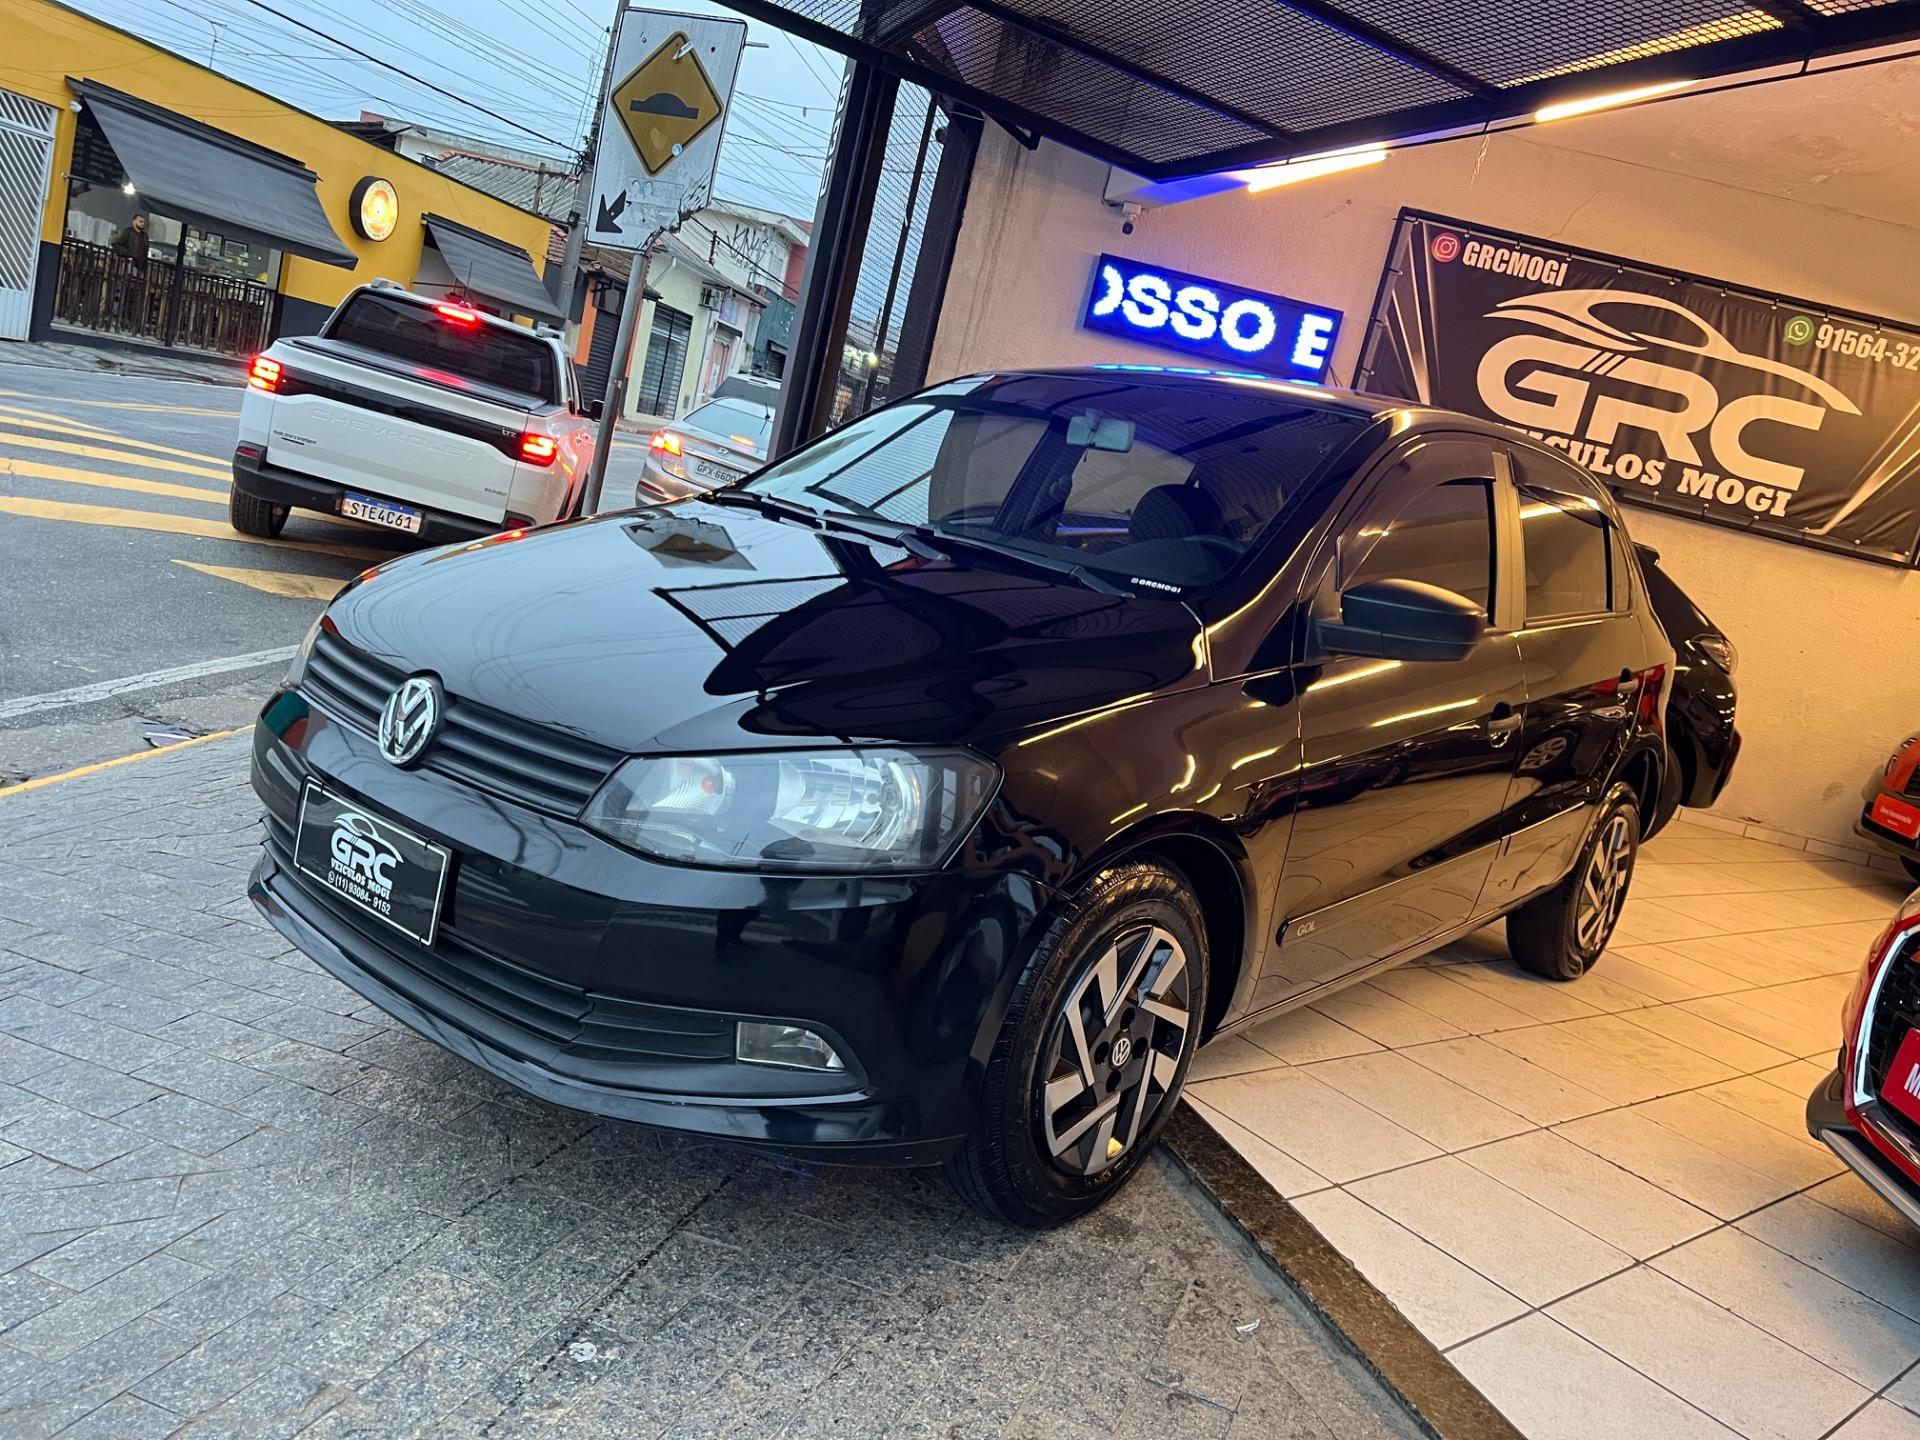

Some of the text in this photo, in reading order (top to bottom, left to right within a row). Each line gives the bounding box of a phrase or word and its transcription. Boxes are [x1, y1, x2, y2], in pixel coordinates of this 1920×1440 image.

[1462, 241, 1568, 287] GRCMOGI
[1476, 333, 1826, 492] GRC
[1677, 466, 1792, 517] MOGI
[350, 502, 412, 529] STE4C61
[331, 828, 397, 890] GRC
[331, 857, 391, 900] VEICULOS MOGI
[372, 896, 392, 915] 9152
[1297, 920, 1316, 936] GOL
